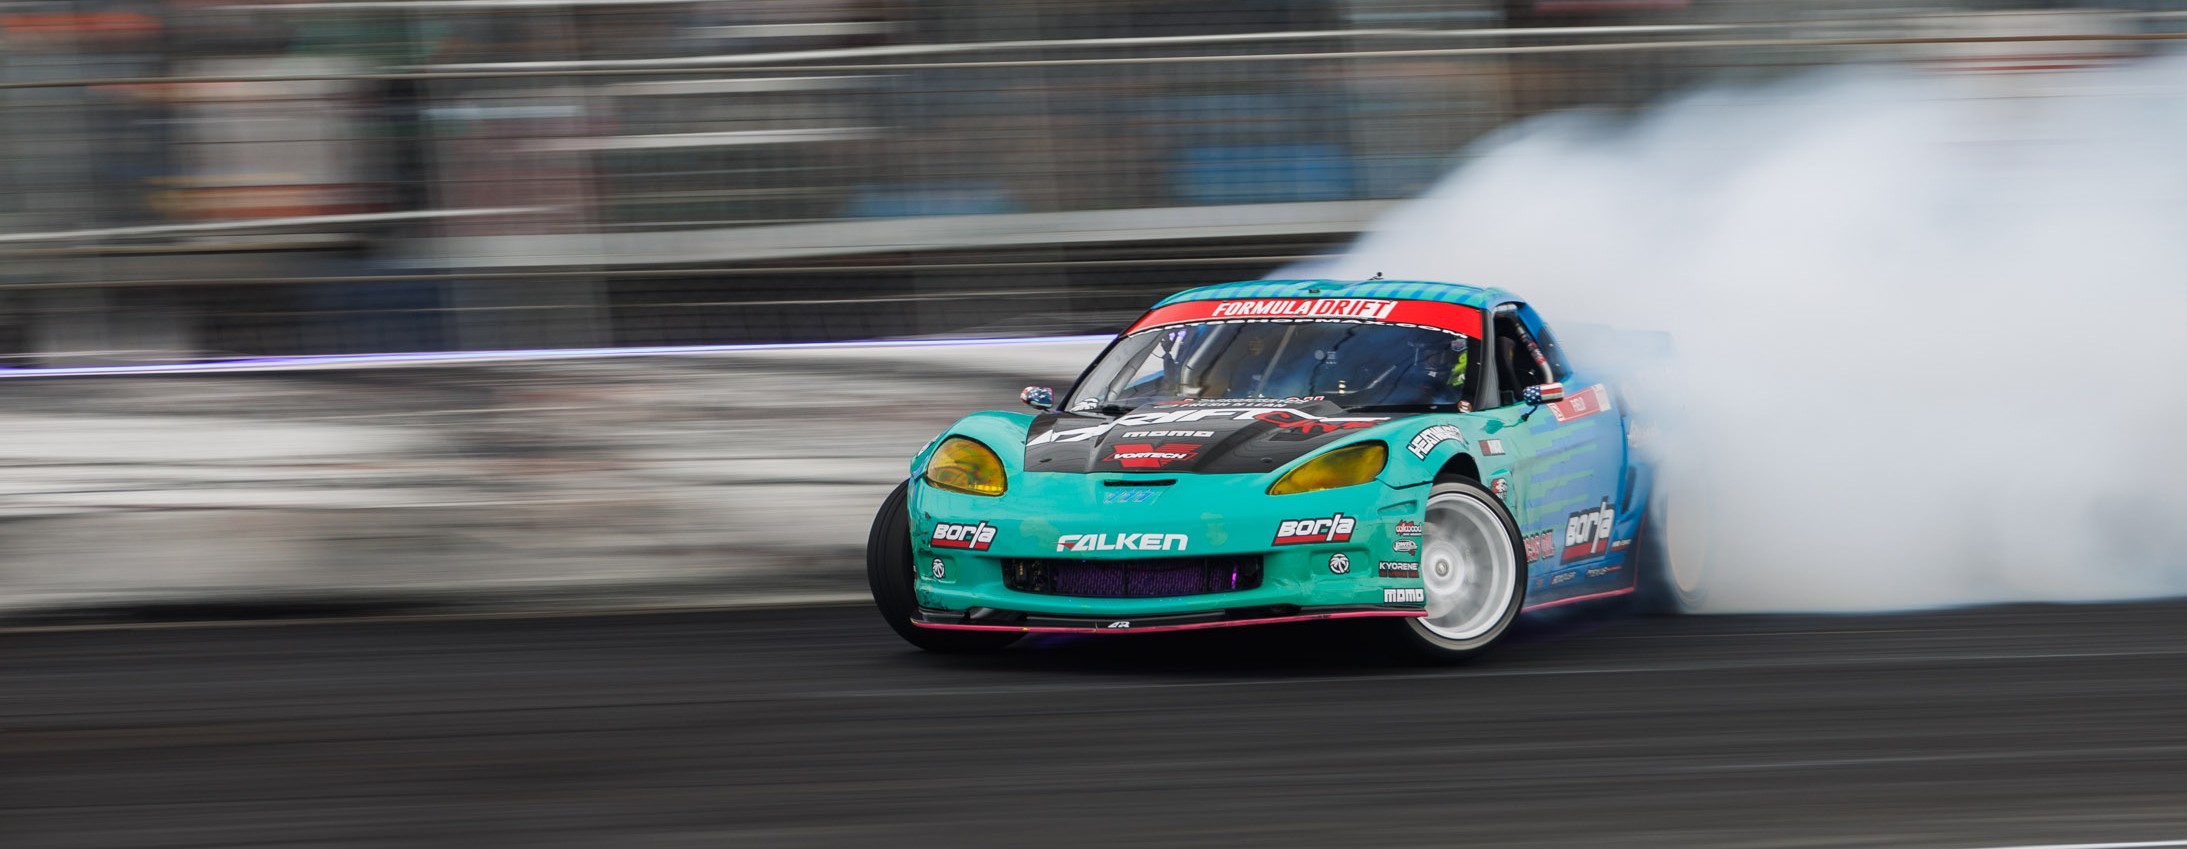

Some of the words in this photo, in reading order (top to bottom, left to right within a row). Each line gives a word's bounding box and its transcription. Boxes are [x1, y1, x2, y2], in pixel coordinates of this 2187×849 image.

[1212, 300, 1309, 317] FORMULA
[1314, 300, 1391, 317] DRIFT
[1114, 452, 1187, 460] VORTECH
[1054, 533, 1189, 552] FALKEN
[1379, 562, 1419, 571] KYORENE
